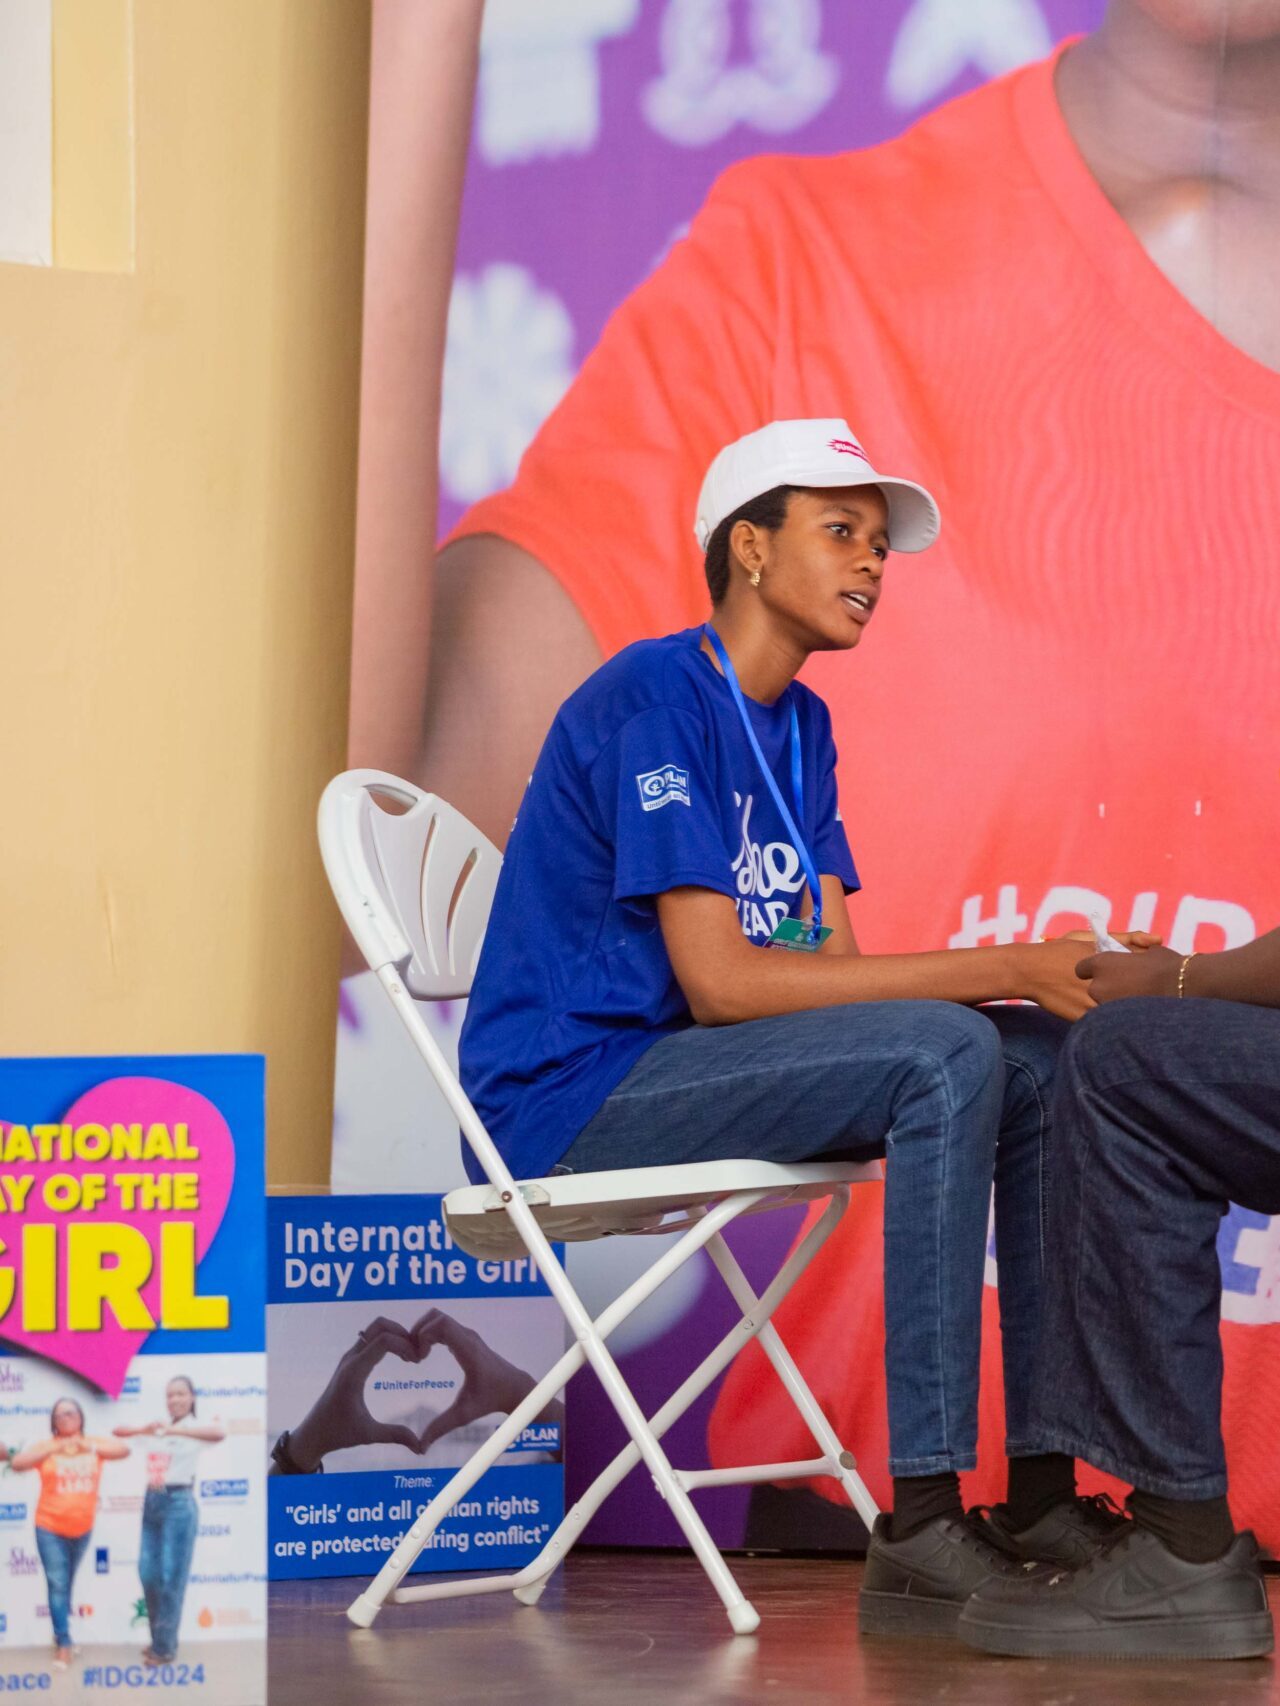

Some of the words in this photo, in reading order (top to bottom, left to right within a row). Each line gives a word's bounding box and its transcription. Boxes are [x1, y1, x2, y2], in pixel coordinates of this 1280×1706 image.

[0, 1122, 199, 1161] ATIONAL
[0, 1174, 34, 1212] Y
[43, 1173, 107, 1211] OF
[113, 1173, 199, 1210] THE
[0, 1222, 229, 1331] IRL
[285, 1258, 354, 1297] Day
[364, 1252, 399, 1286] of
[409, 1253, 467, 1285] the
[522, 1427, 559, 1442] PLAN
[394, 1475, 435, 1488] Theme:
[347, 1501, 383, 1522] and
[388, 1499, 411, 1520] all
[486, 1496, 539, 1520] rights
[274, 1541, 306, 1557] are
[311, 1531, 405, 1560] protected
[0, 1671, 52, 1692] ace
[83, 1664, 205, 1689] #IDG2024
